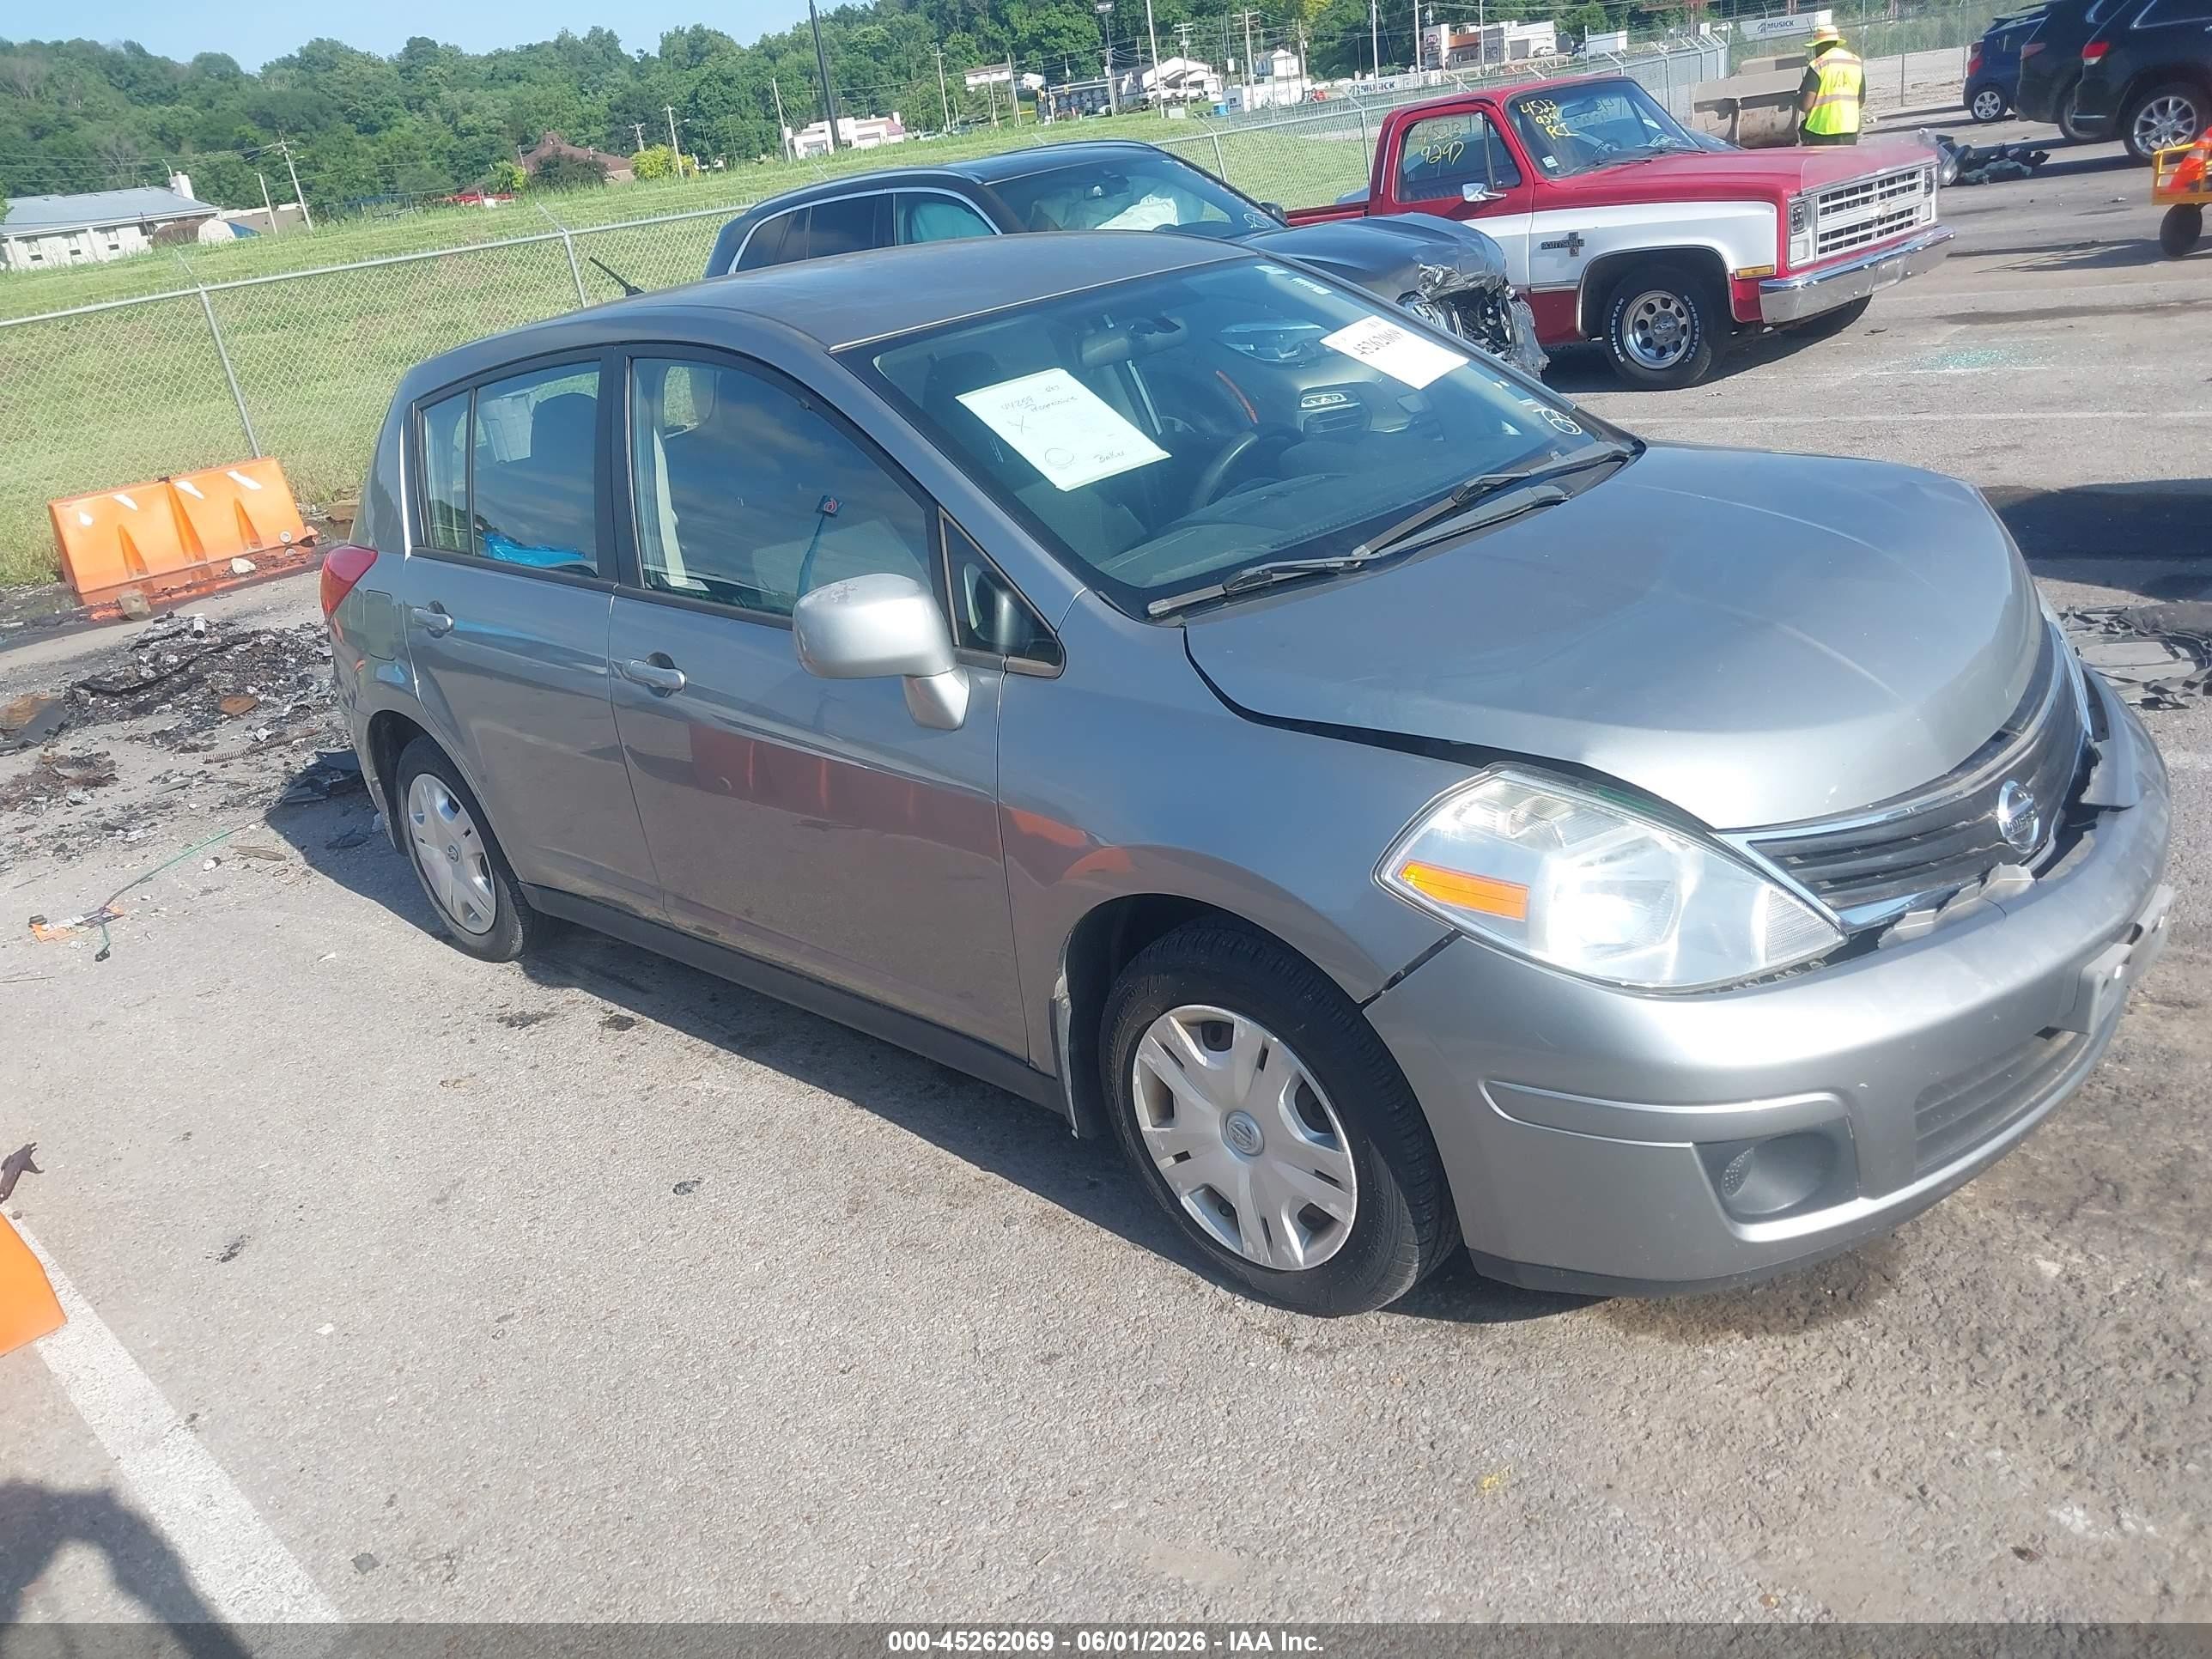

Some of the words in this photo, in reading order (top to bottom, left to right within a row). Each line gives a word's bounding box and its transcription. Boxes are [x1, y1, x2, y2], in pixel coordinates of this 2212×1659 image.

[1767, 20, 1794, 28] MUSICK
[1519, 99, 1557, 115] 4523
[1421, 141, 1464, 165] 9297
[1352, 329, 1404, 356] 45262069
